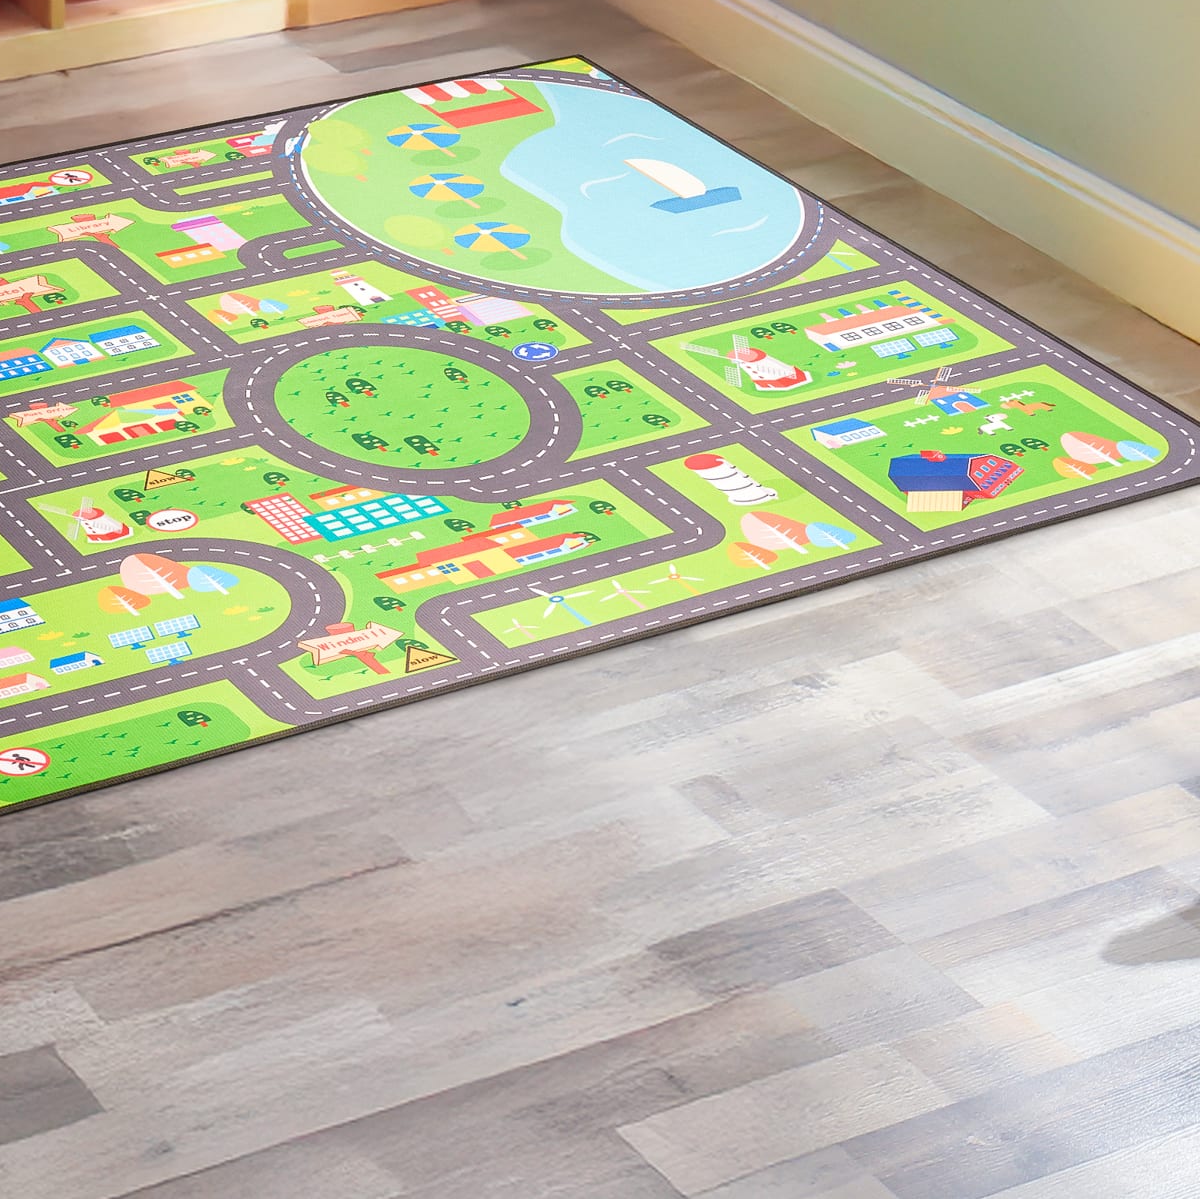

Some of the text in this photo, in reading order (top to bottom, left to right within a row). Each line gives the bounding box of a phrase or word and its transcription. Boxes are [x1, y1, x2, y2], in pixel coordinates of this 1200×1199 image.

[67, 221, 109, 233] Library
[149, 476, 176, 485] slow
[156, 514, 192, 527] stop
[317, 628, 387, 651] Windmill
[410, 655, 438, 666] slow
